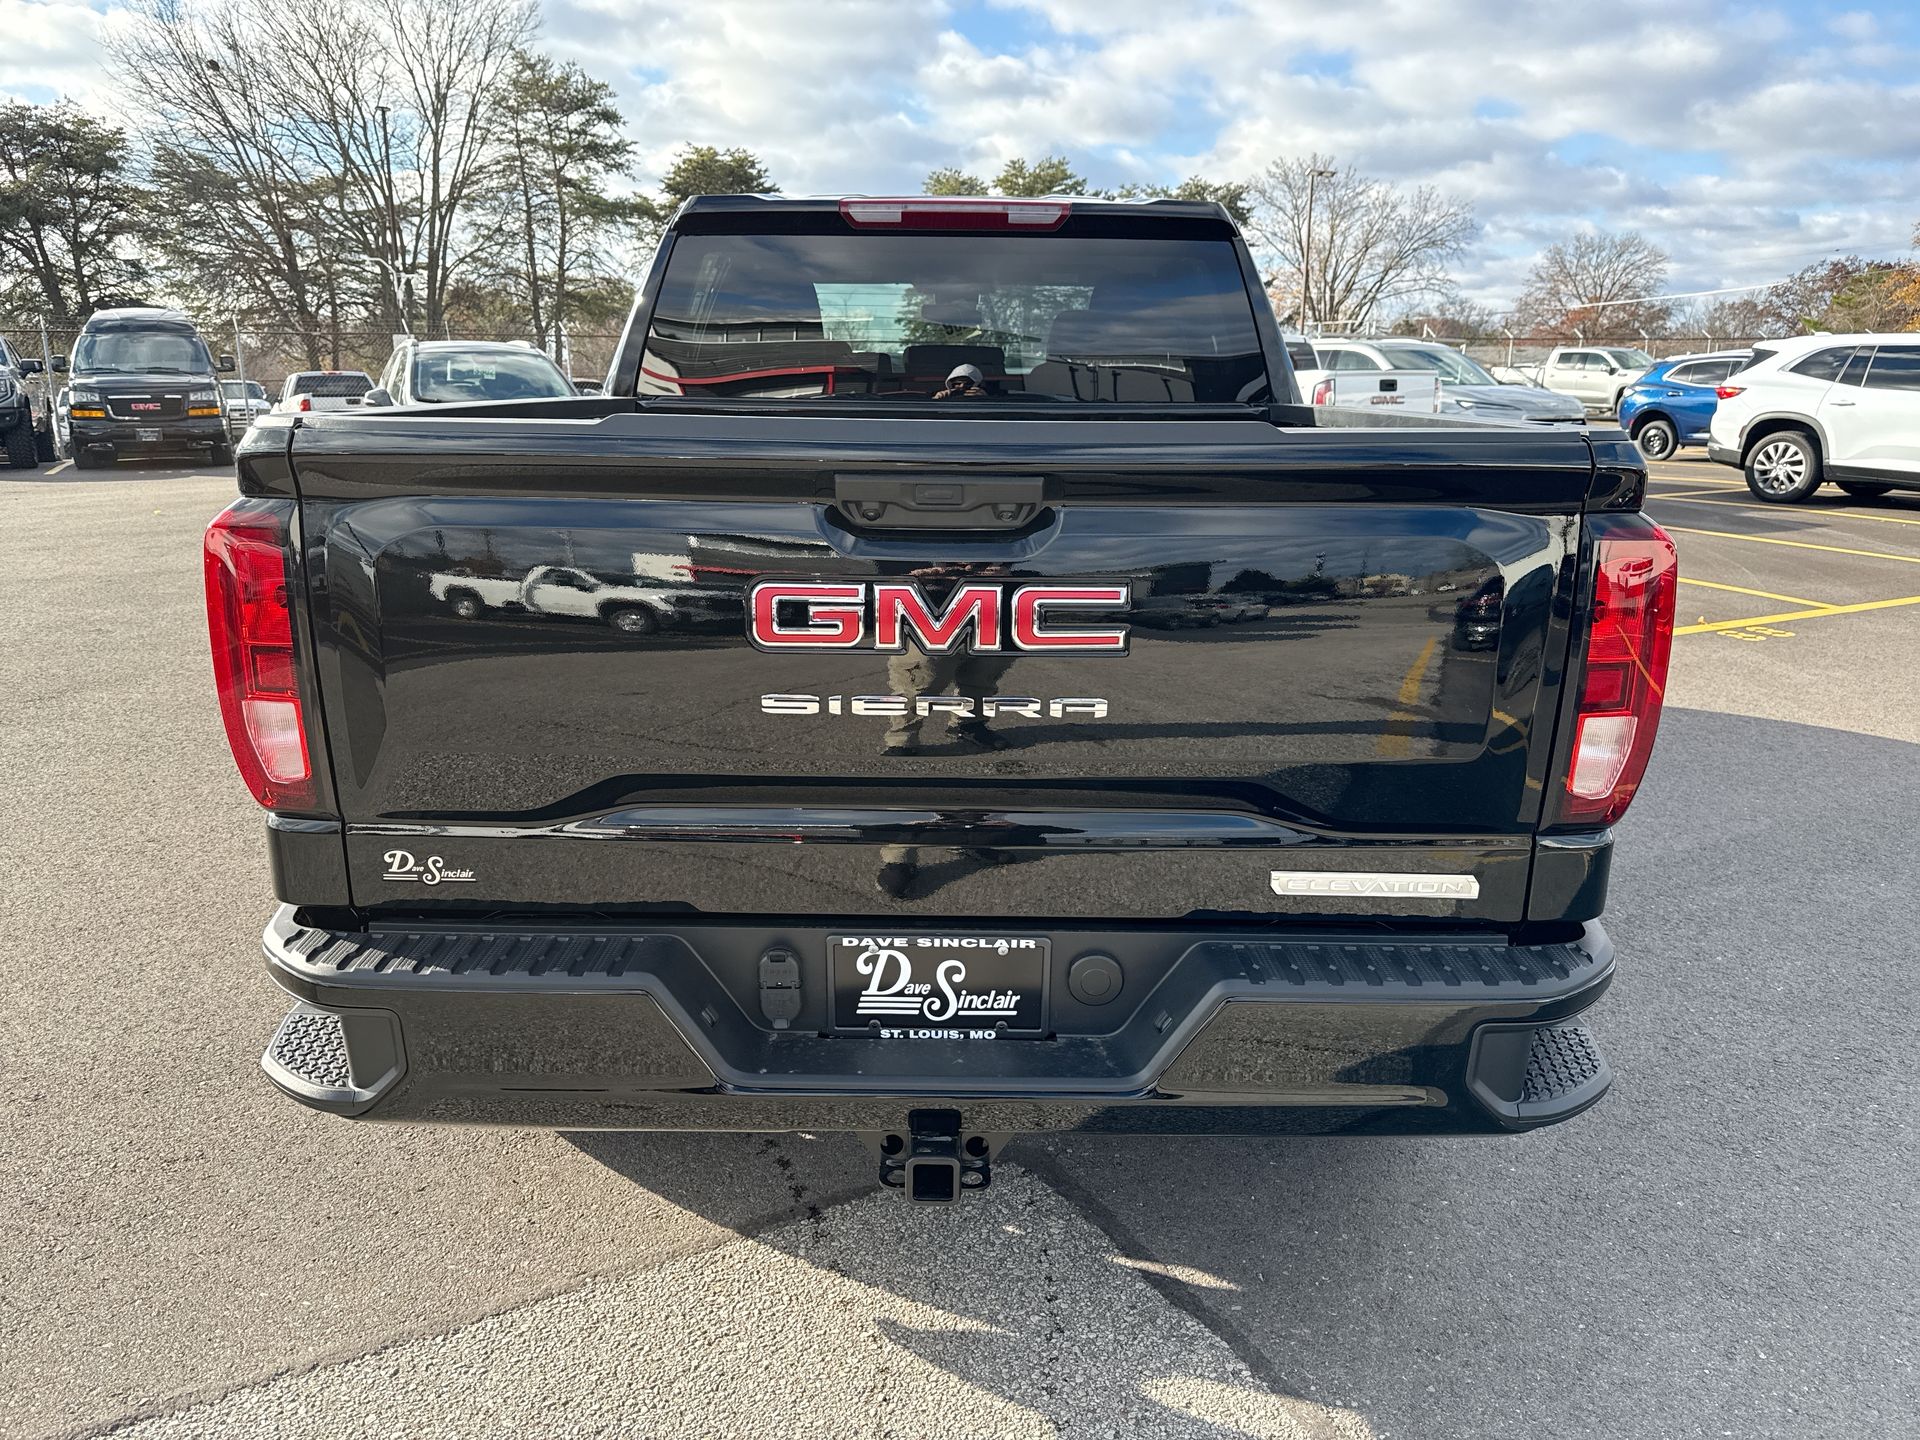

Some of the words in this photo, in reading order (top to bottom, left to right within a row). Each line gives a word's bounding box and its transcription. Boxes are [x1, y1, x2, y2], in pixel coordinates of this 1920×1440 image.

[1370, 395, 1405, 405] GMC
[748, 579, 1131, 653] GMC
[761, 694, 1109, 718] SIERRA
[383, 850, 425, 872] Dave
[422, 856, 474, 885] Sinclair
[1287, 877, 1464, 894] ELEVATION
[842, 937, 908, 947] DAVE
[916, 937, 1037, 949] SINCLAIR
[856, 949, 932, 996] Dave
[923, 959, 1021, 1022] Sinclair
[880, 1029, 904, 1039] ST.
[909, 1029, 964, 1040] LOUIS,
[970, 1030, 996, 1040] MO
